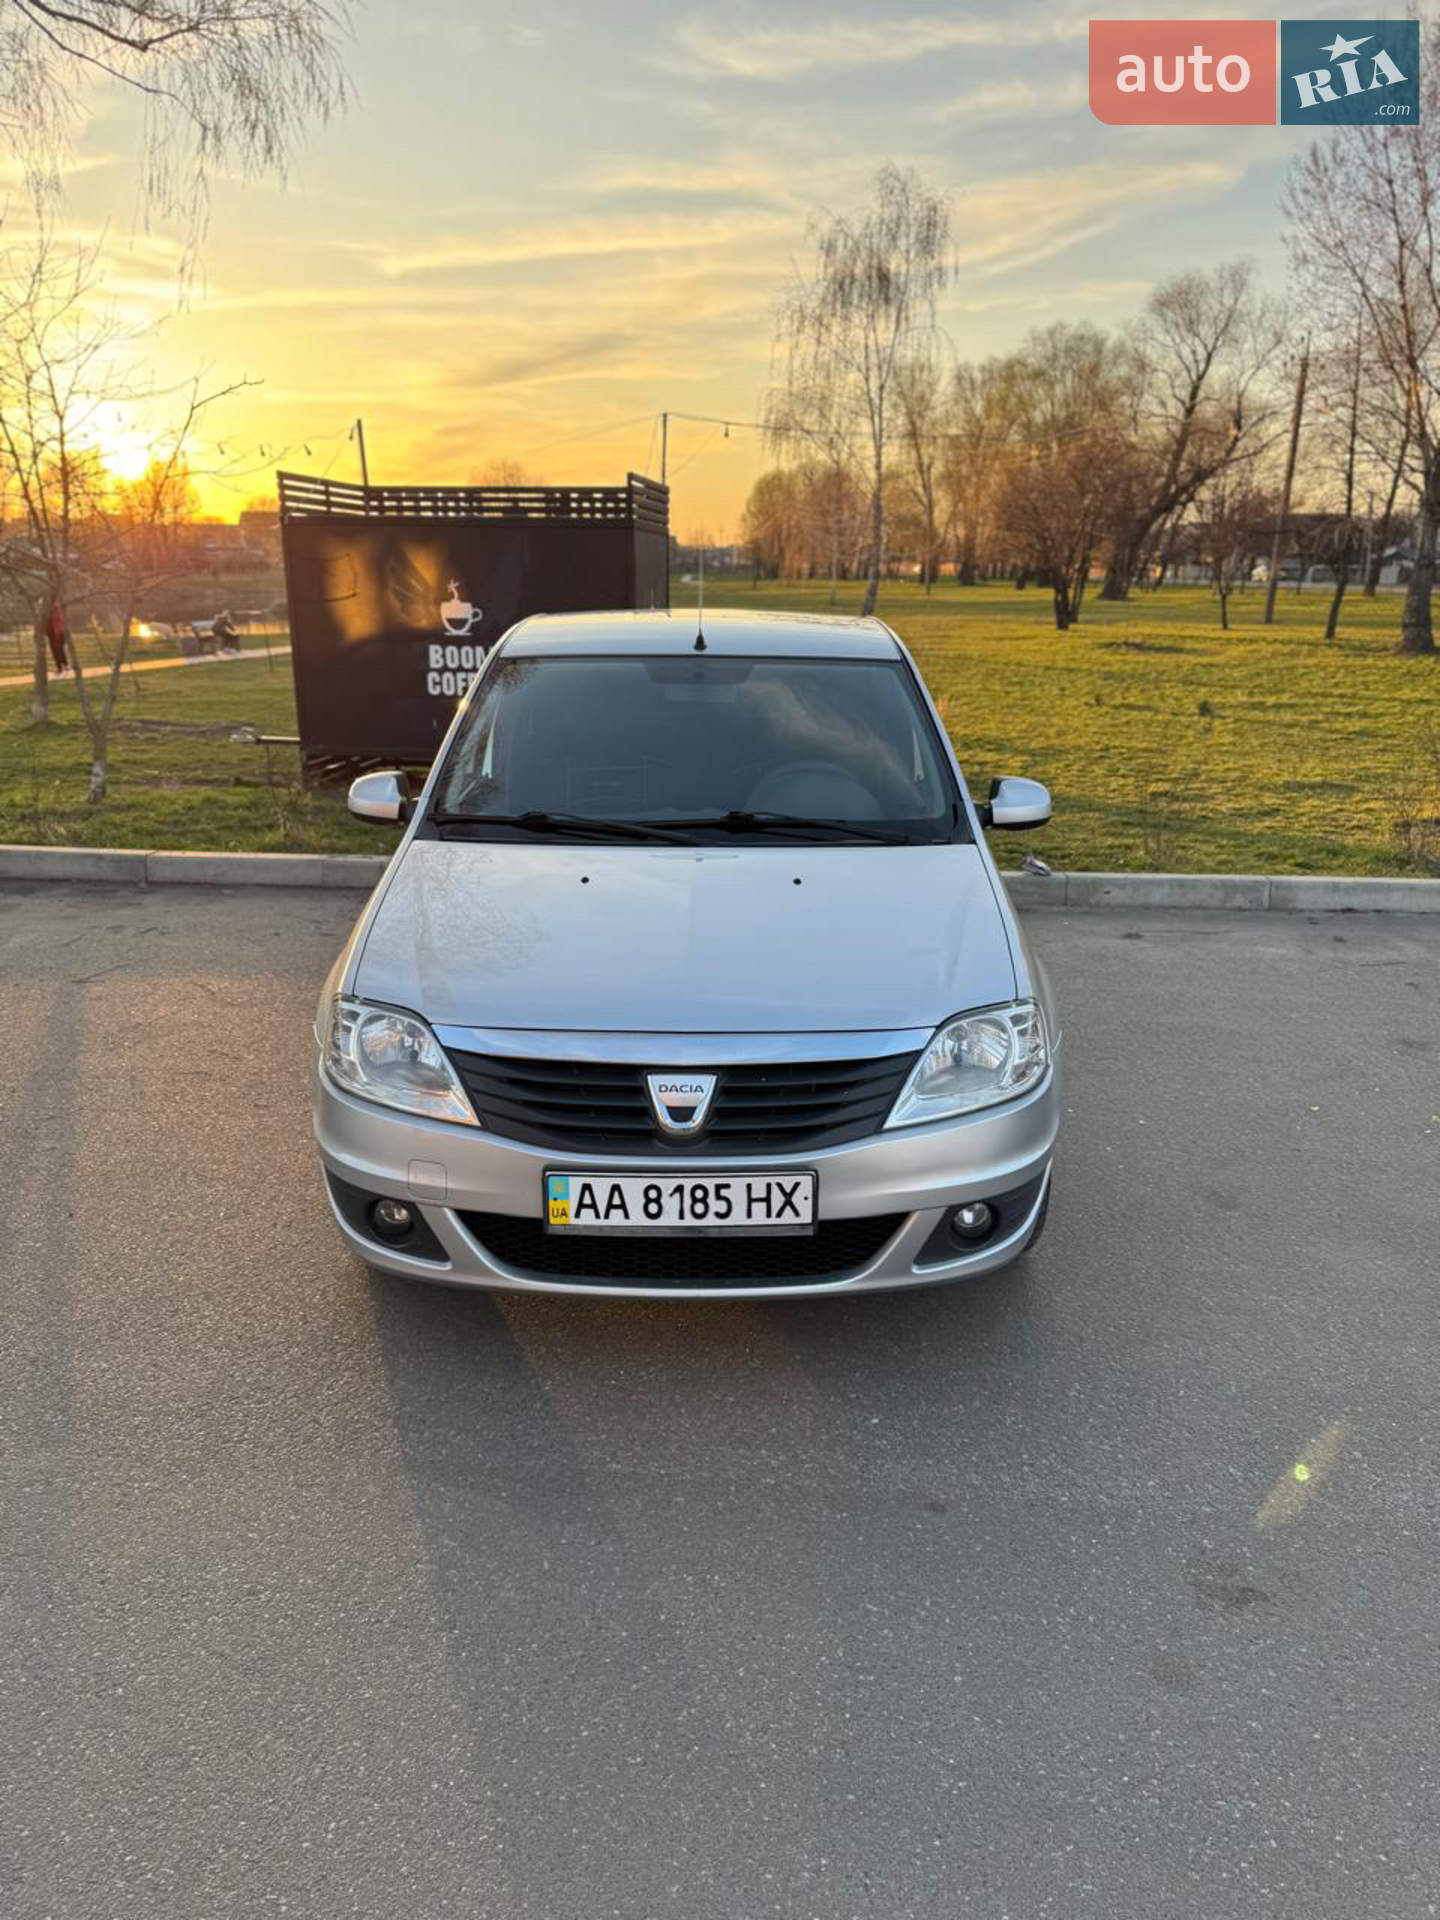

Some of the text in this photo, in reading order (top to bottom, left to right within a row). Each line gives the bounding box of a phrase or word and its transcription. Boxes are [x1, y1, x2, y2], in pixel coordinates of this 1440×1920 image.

[658, 1084, 704, 1093] DACIA
[574, 1182, 801, 1220] AA 8185 HX
[551, 1208, 568, 1219] UA
